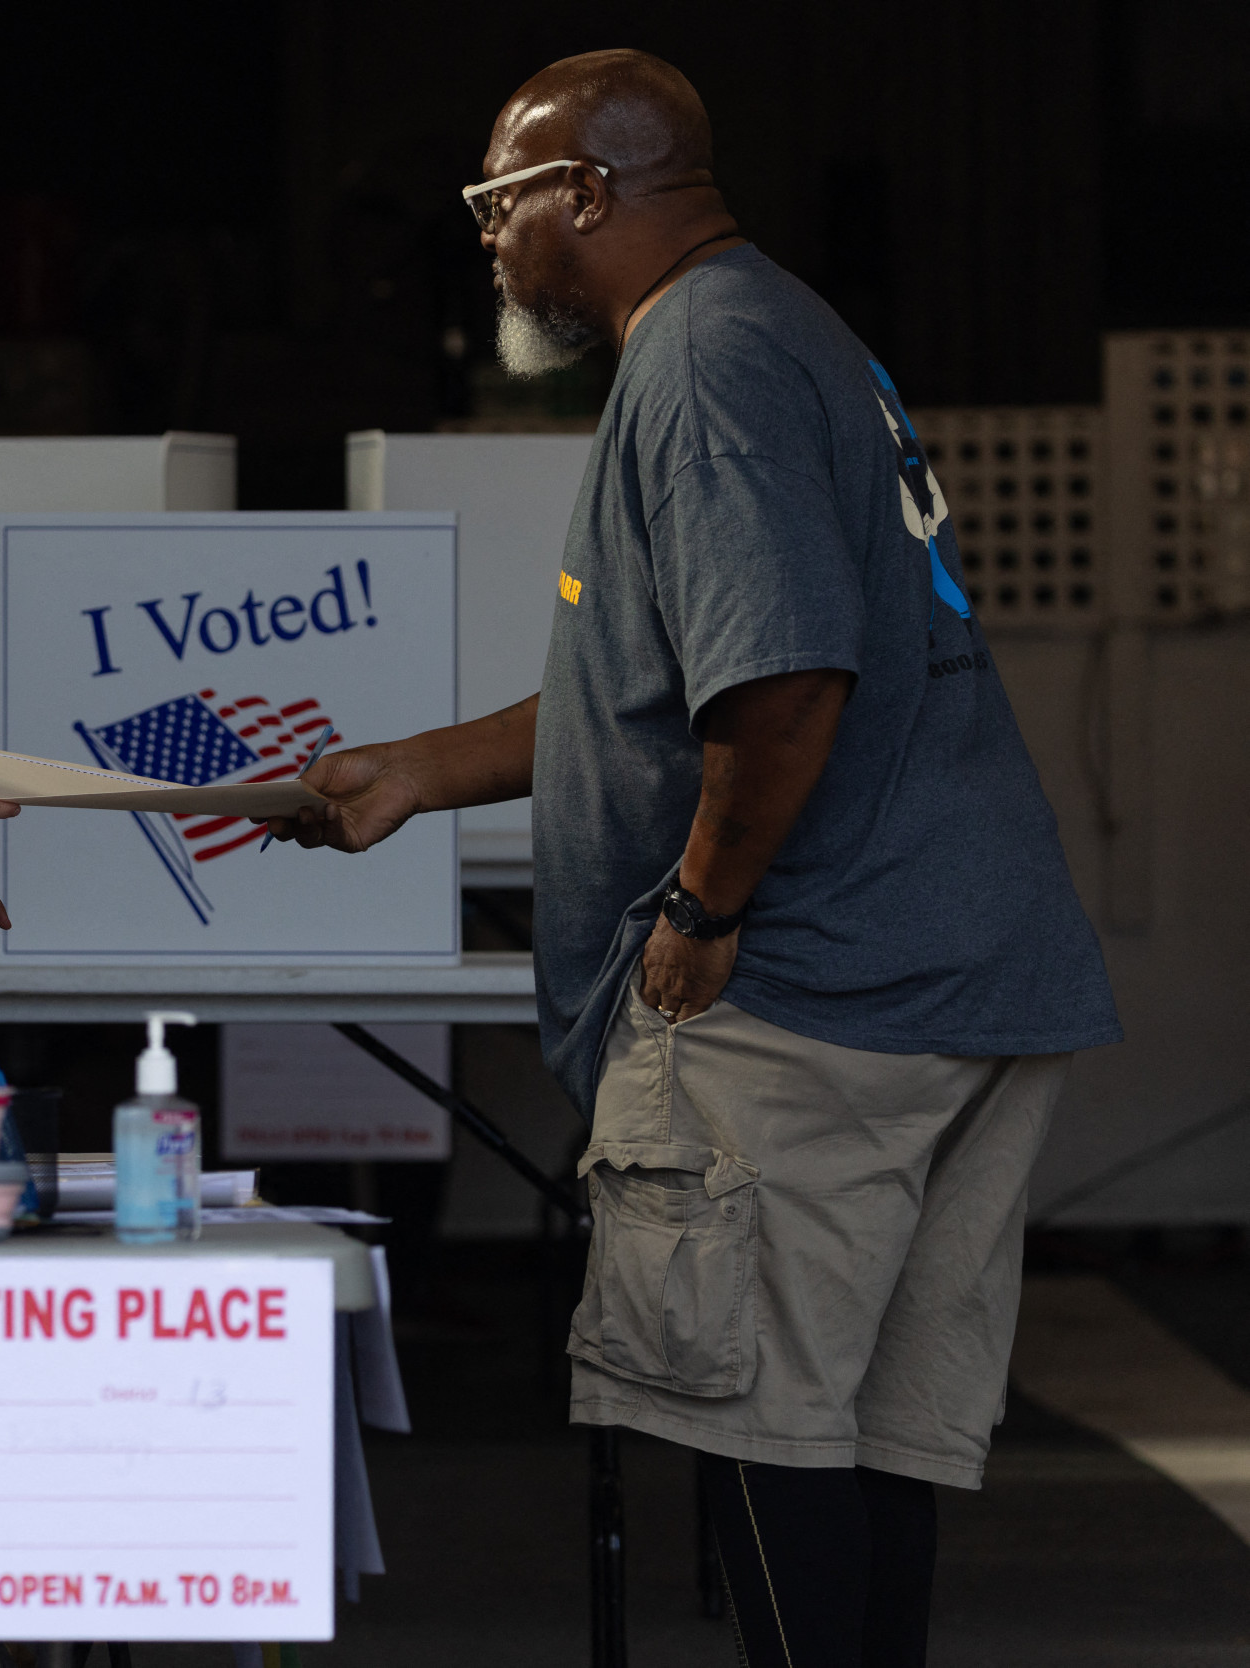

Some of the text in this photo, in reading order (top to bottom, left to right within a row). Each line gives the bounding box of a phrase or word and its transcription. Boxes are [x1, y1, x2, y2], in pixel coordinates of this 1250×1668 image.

[82, 559, 377, 677] I Voted!
[117, 1288, 287, 1340] PLACE
[188, 1376, 228, 1410] 13
[178, 1574, 220, 1606] TO
